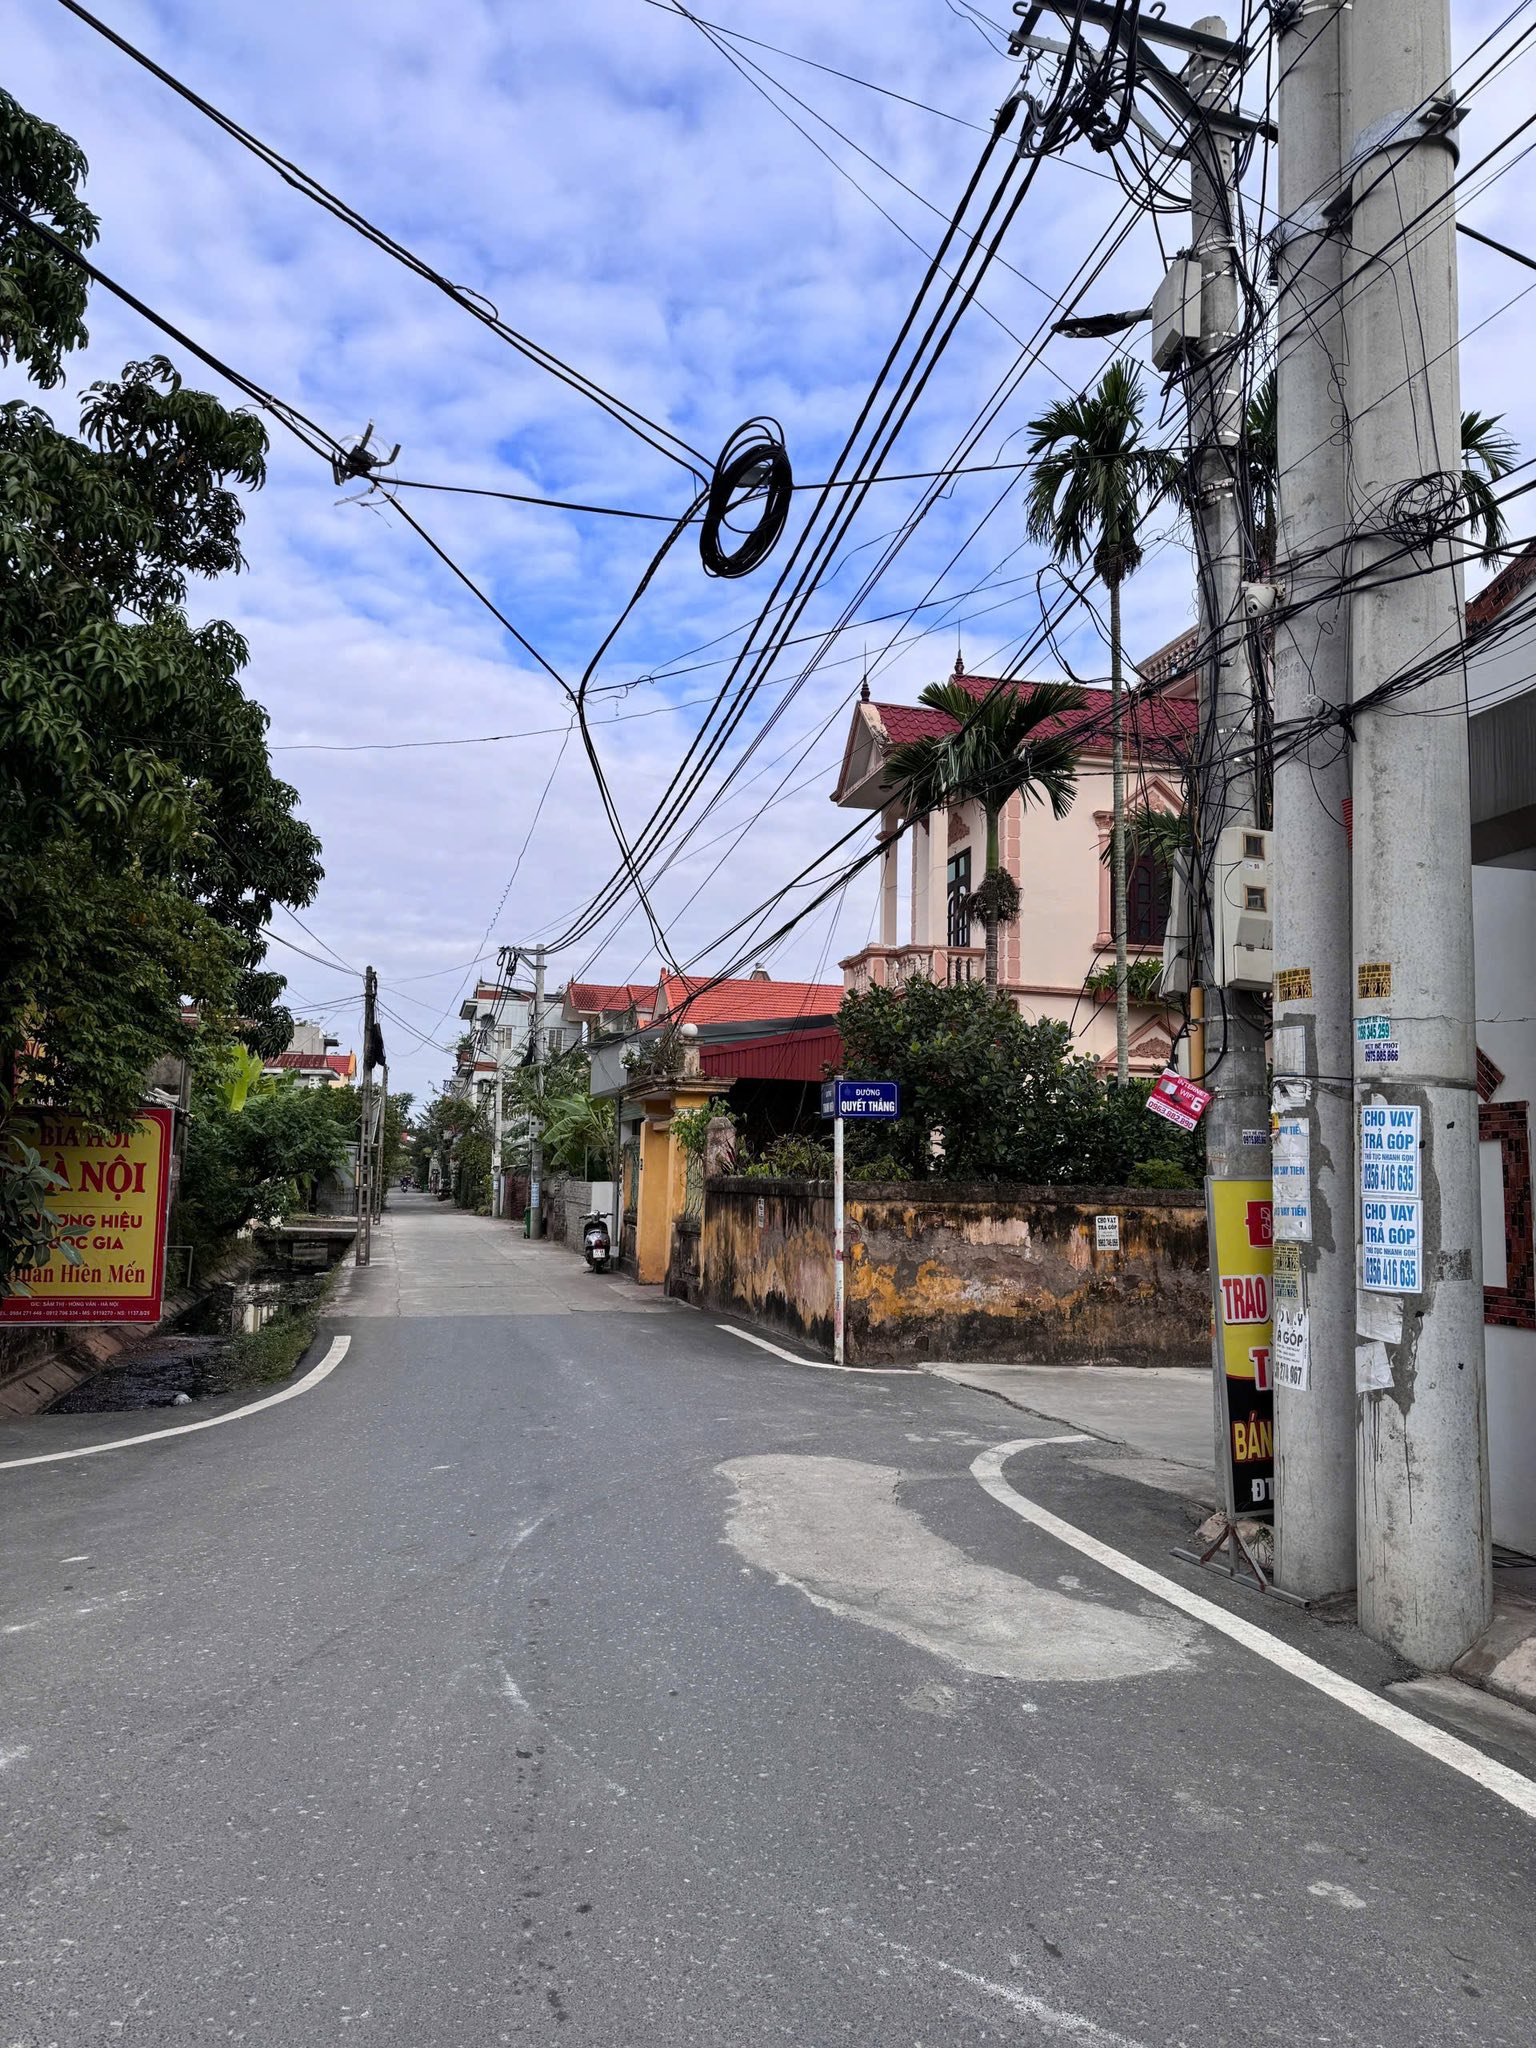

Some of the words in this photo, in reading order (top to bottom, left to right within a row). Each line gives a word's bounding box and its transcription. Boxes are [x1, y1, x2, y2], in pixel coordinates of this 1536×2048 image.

[855, 1087, 880, 1096] ĐƯỜNG
[1177, 1078, 1209, 1098] INTERNET
[1180, 1088, 1195, 1101] WIFI
[841, 1098, 865, 1112] QUYẾT
[868, 1098, 895, 1112] THẮNG
[1191, 1096, 1205, 1112] 6
[1364, 1110, 1386, 1127] CHO
[1390, 1110, 1414, 1127] VAY
[1364, 1128, 1384, 1149] TRẢ
[1387, 1131, 1415, 1150] GÓP
[78, 1153, 147, 1201] NỘI
[1381, 1164, 1396, 1191] 416
[1397, 1164, 1414, 1192] 635
[100, 1210, 143, 1232] HIỆU
[1365, 1203, 1387, 1220] CHO
[1390, 1204, 1415, 1221] VAY
[93, 1237, 124, 1250] GIA
[1365, 1221, 1385, 1243] TRẢ
[1388, 1224, 1416, 1245] GÓP
[108, 1260, 145, 1284] Mến
[1383, 1258, 1398, 1287] 416
[1400, 1259, 1416, 1288] 635
[1222, 1276, 1267, 1320] TRAO
[1283, 1329, 1304, 1347] GÓP
[1234, 1413, 1272, 1460] BÁN
